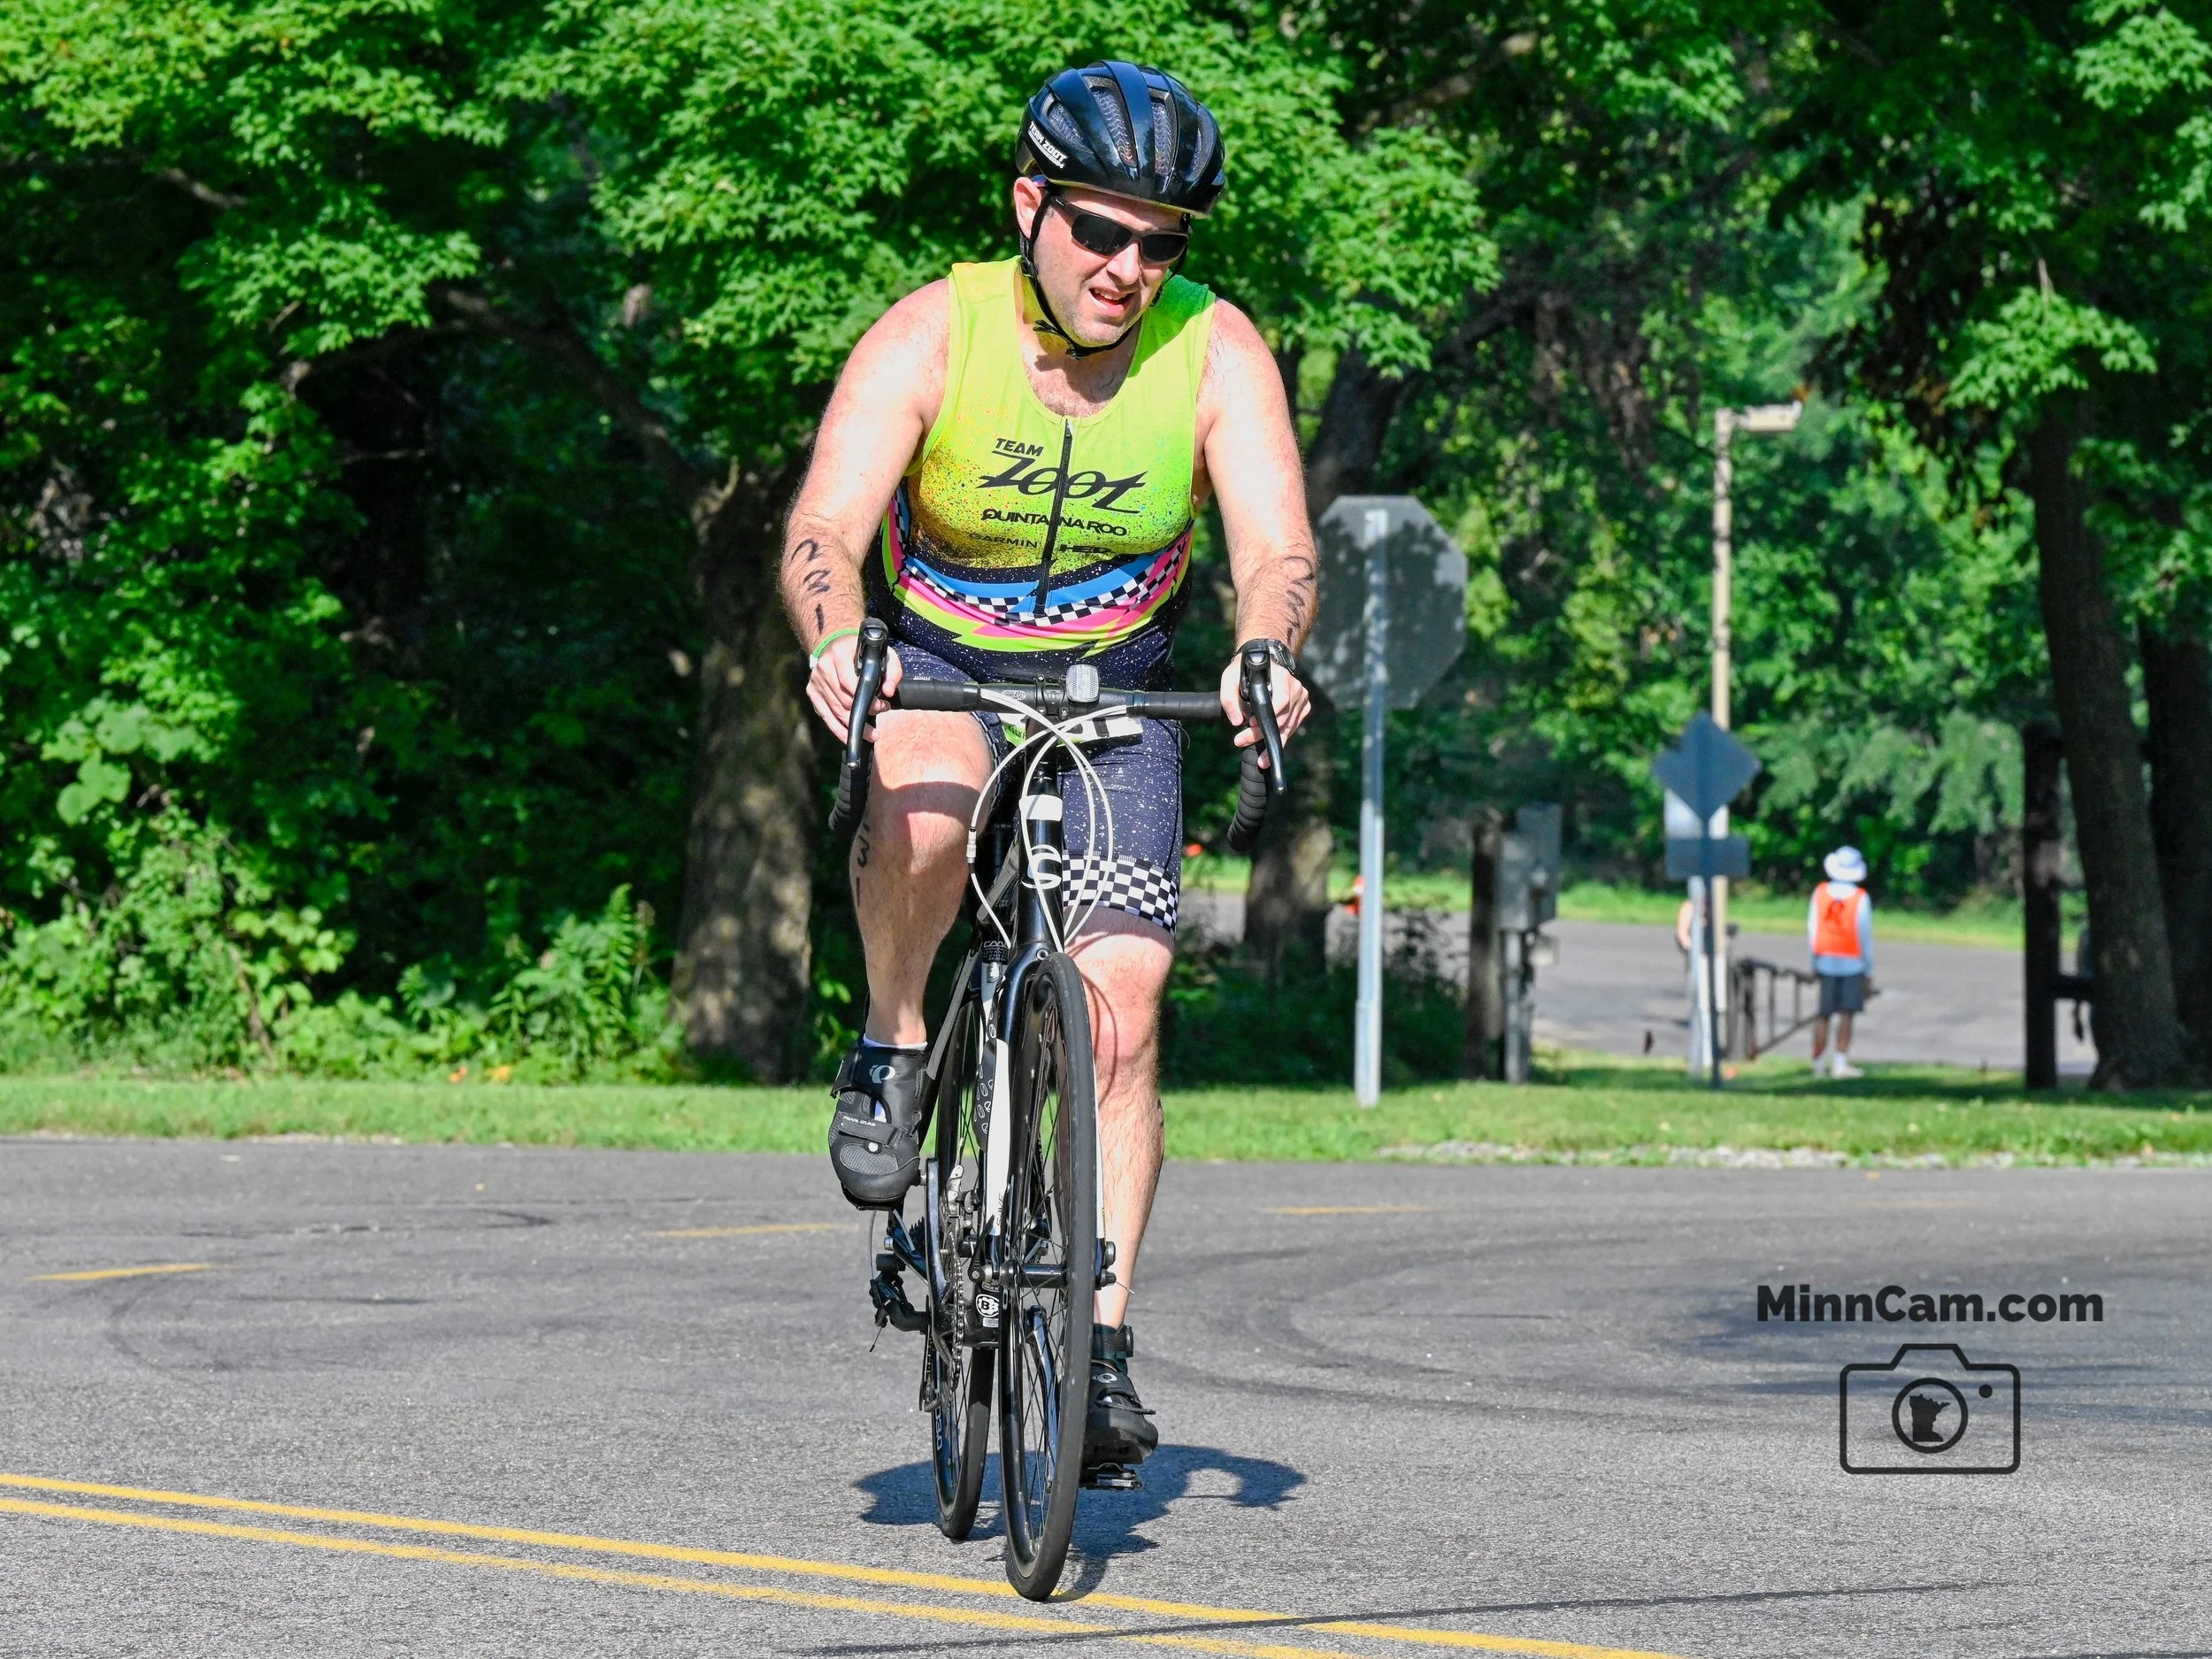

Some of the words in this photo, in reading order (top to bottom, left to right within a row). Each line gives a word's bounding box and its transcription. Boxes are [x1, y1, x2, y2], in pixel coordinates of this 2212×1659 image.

[1029, 120, 1045, 143] TEAM
[1042, 140, 1067, 163] ZOOT
[995, 437, 1044, 457] TEAM
[969, 533, 1038, 549] GARMIN
